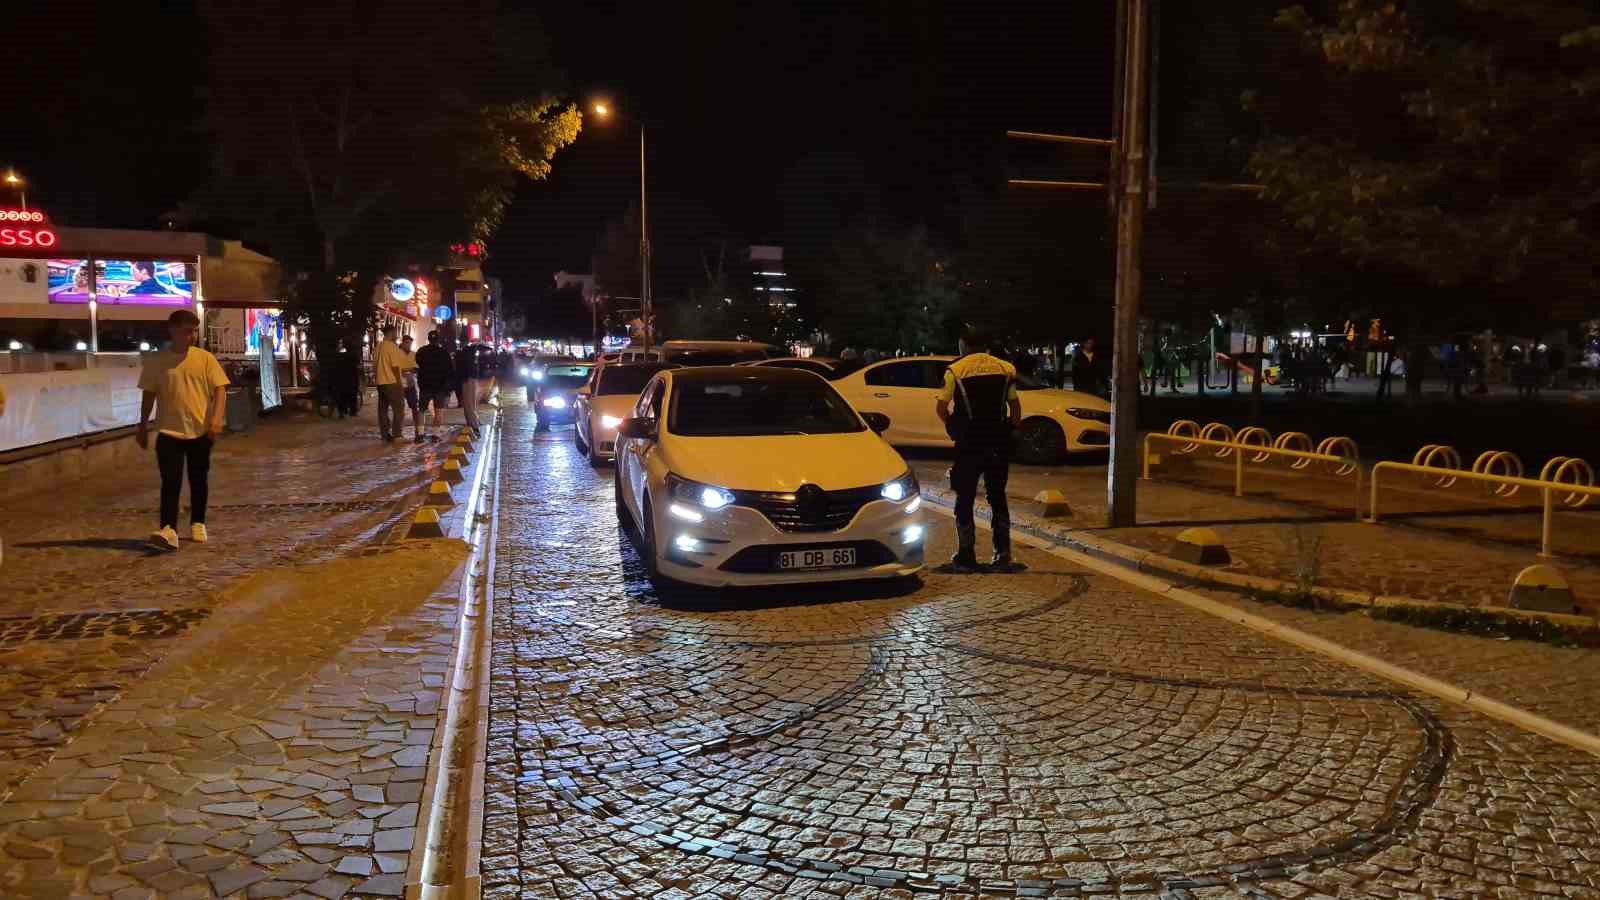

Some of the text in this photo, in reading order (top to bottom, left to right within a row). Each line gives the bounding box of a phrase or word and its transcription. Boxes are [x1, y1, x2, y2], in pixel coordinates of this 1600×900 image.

[0, 229, 55, 246] SSO
[782, 549, 855, 567] 81 DB 661
